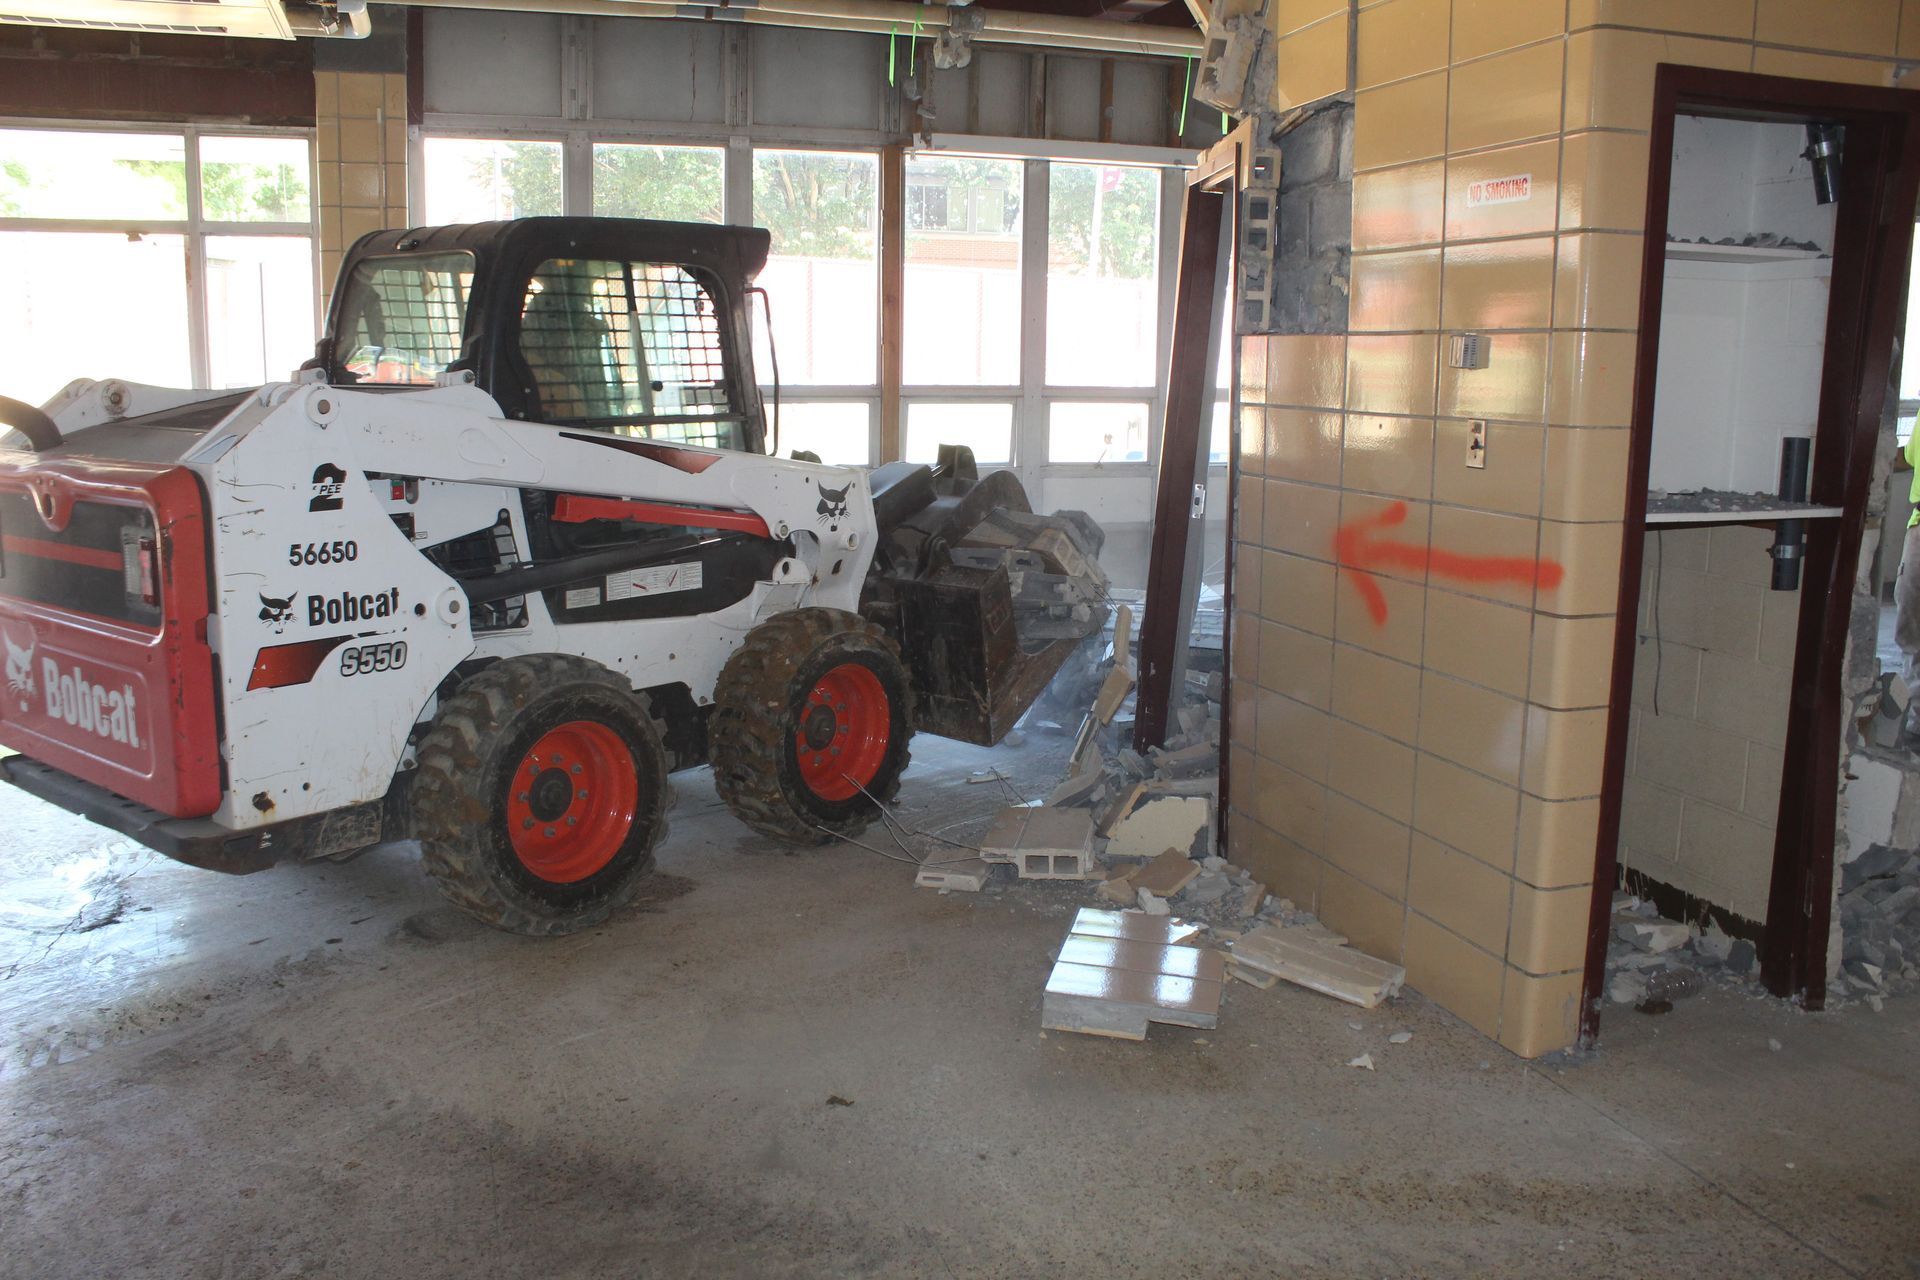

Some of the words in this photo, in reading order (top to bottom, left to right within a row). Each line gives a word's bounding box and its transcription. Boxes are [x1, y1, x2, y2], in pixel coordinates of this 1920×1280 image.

[1470, 184, 1481, 202] NO
[1486, 177, 1528, 200] SMOKING
[289, 540, 358, 566] 56650
[308, 587, 399, 626] Bobcat
[341, 641, 408, 677] S550
[42, 657, 139, 748] Bobcat
